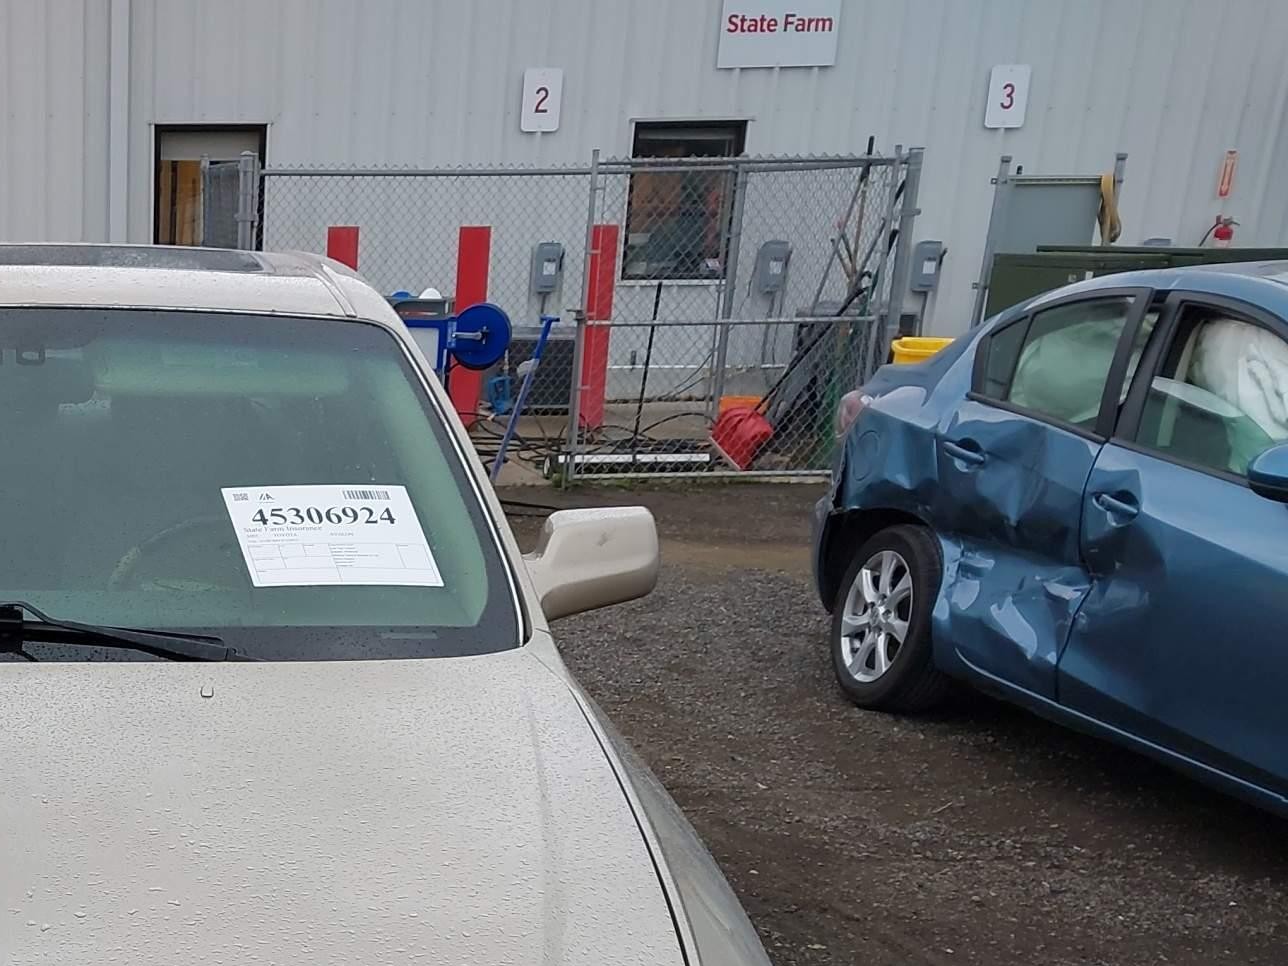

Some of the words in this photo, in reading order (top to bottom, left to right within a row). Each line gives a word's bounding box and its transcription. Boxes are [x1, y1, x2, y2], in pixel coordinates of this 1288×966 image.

[726, 13, 778, 33] State
[783, 13, 833, 32] Farm
[534, 86, 549, 114] 2
[999, 83, 1015, 110] 3
[251, 506, 397, 526] 45306924
